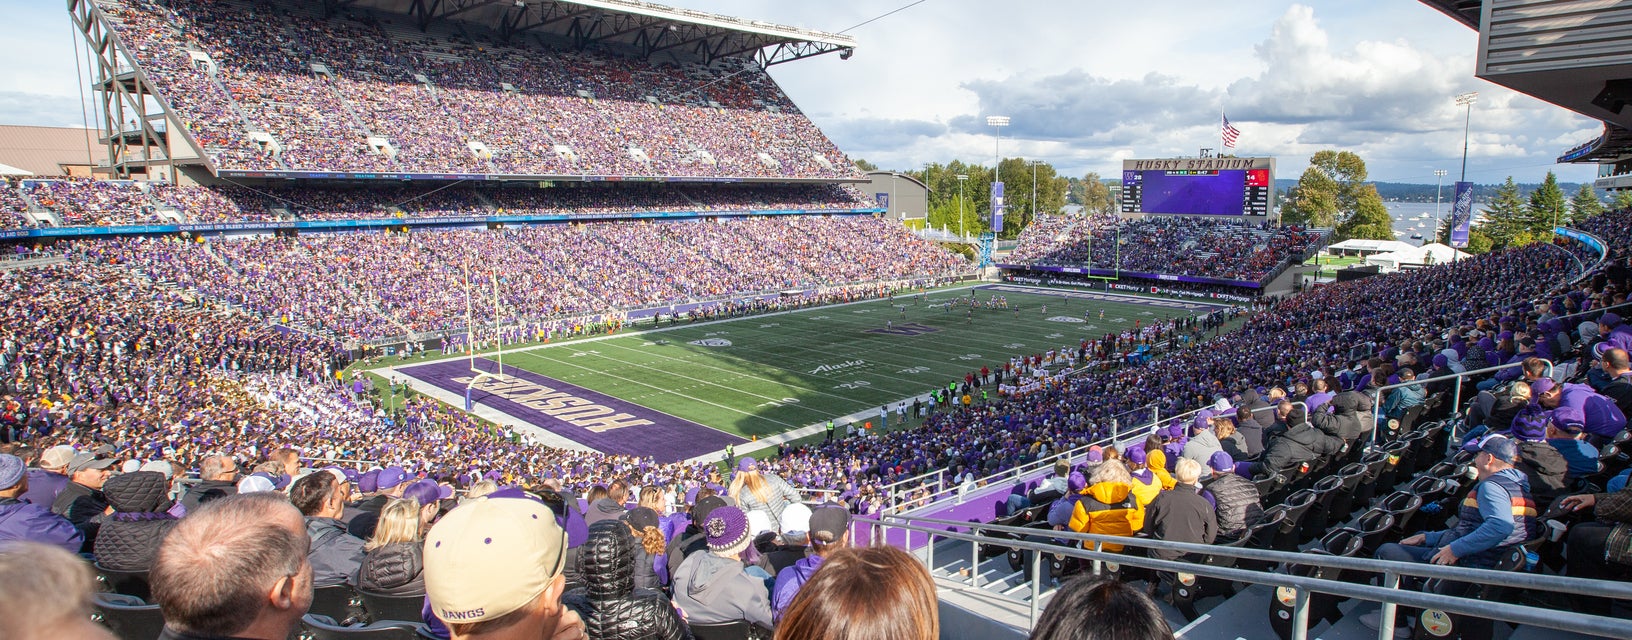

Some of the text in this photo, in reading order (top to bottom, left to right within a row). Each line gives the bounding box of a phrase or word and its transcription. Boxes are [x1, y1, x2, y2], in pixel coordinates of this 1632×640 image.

[1136, 160, 1255, 169] HUSKY STADIUM
[807, 359, 865, 375] Alaska
[840, 380, 871, 389] 20
[441, 607, 486, 620] DAWGS
